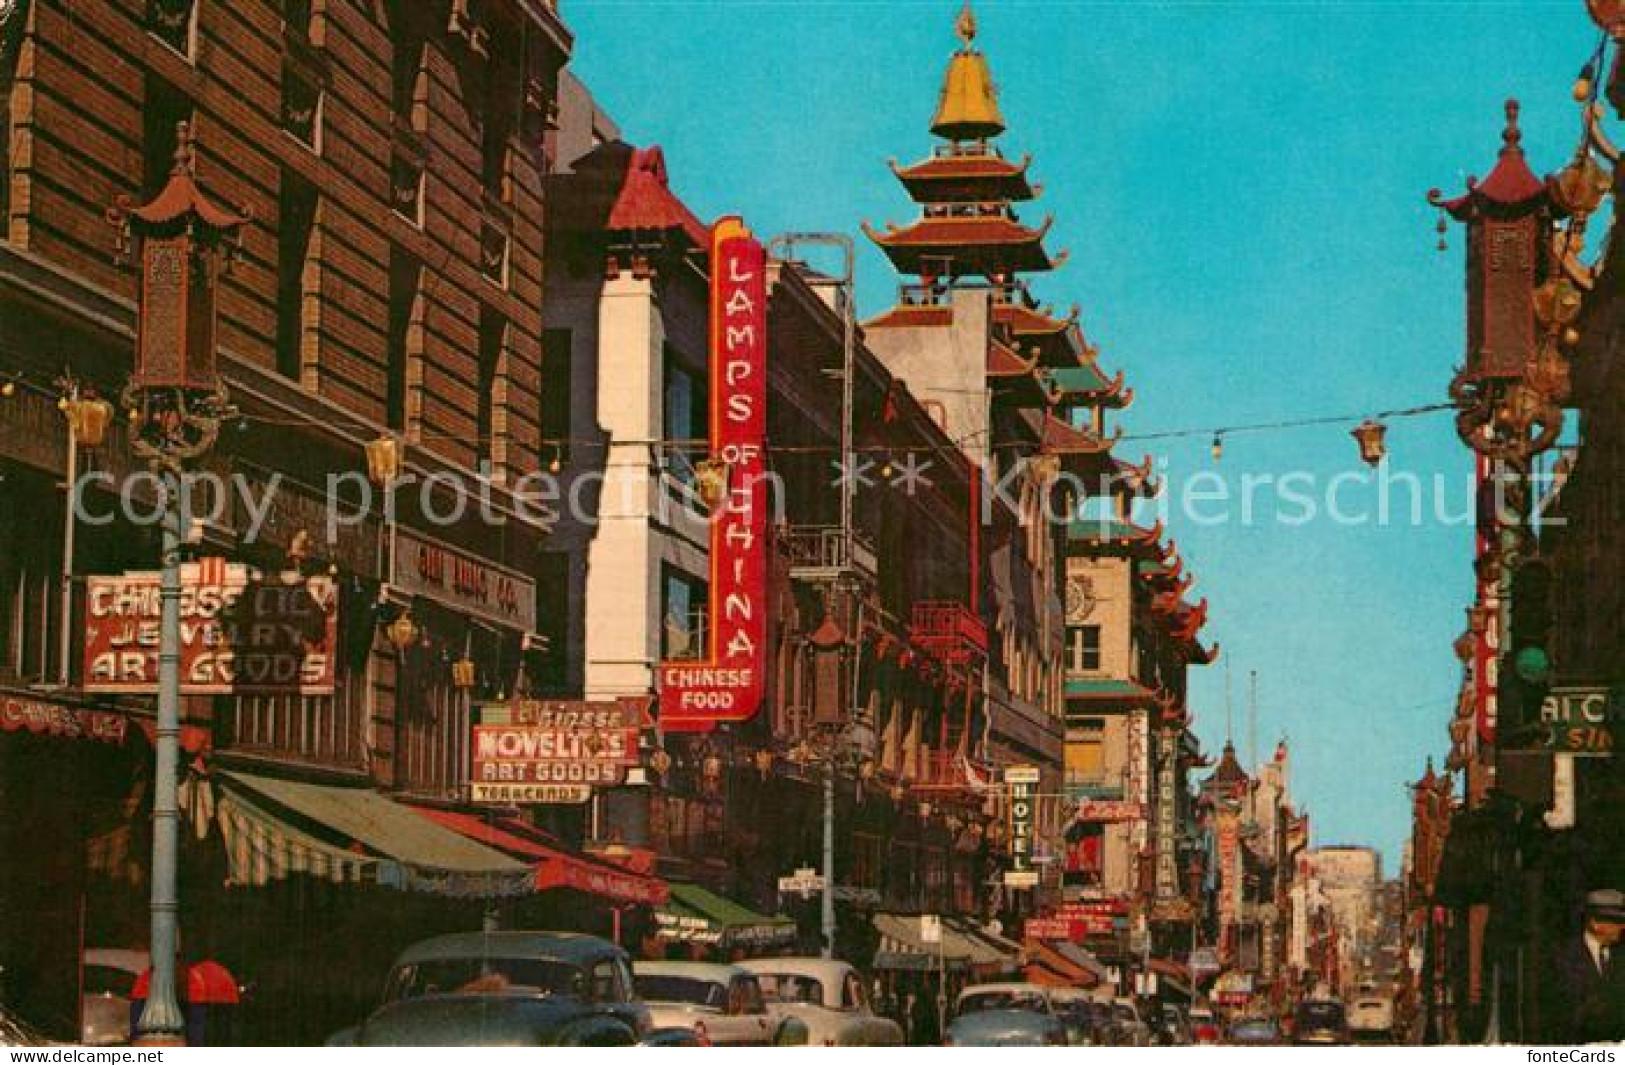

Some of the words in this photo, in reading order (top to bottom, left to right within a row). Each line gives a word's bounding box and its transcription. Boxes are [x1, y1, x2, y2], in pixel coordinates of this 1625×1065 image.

[726, 258, 754, 421] LAMPS
[721, 444, 760, 464] OF
[725, 487, 755, 658] CHINA
[189, 652, 327, 683] GOODS
[666, 668, 752, 688] CHINESE
[682, 691, 734, 710] FOOD
[482, 762, 526, 781] ART
[535, 762, 616, 781] GOODS
[1013, 783, 1029, 869] HOTEL
